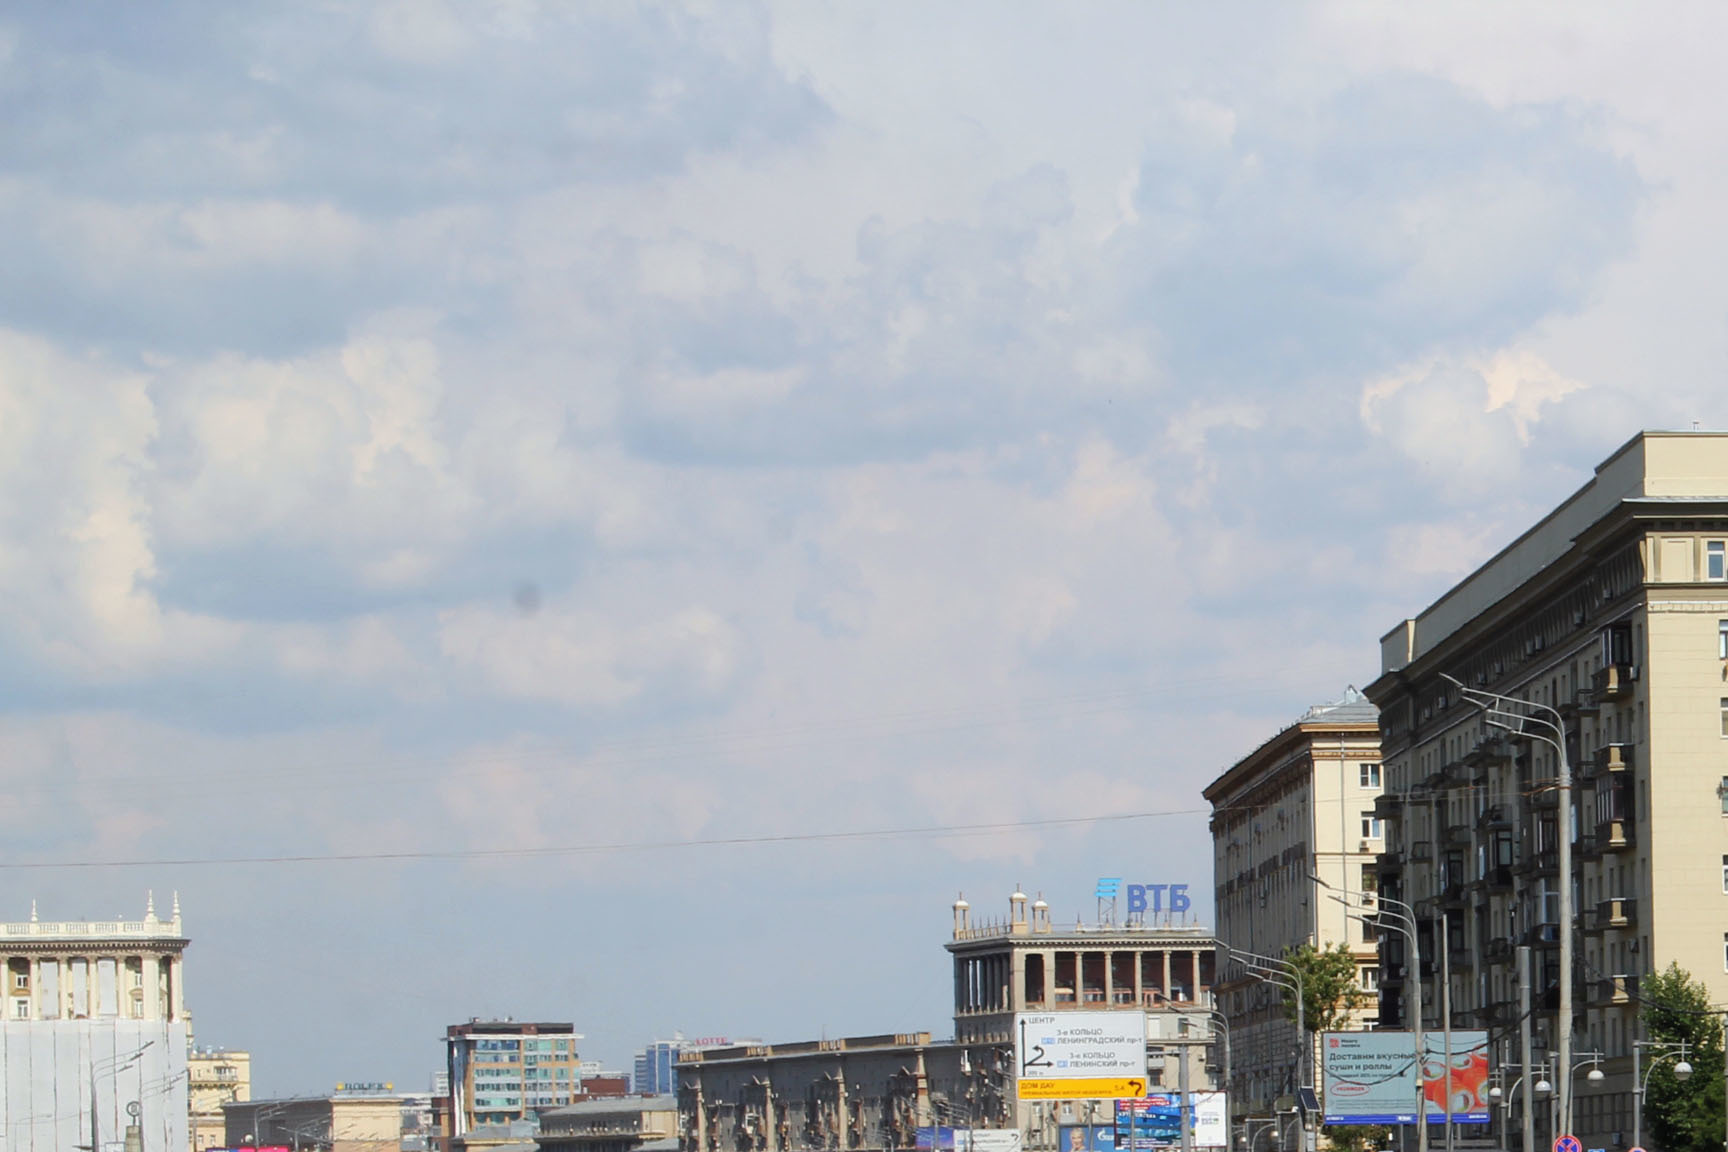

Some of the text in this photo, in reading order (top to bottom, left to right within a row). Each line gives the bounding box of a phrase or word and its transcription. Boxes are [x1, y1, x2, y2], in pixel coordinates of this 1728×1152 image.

[1128, 884, 1191, 913] ВТБ
[1028, 1017, 1056, 1025] ЦЕНТР
[1070, 1028, 1103, 1036] КОЛЬЦО
[1057, 1036, 1125, 1045] ЛЕНИНГРАДСКИЙ
[1329, 1052, 1375, 1062] Доставим
[1070, 1060, 1118, 1069] ЛЕНИНСКИЙ
[1329, 1064, 1354, 1072] суши
[1363, 1064, 1393, 1072] роллы
